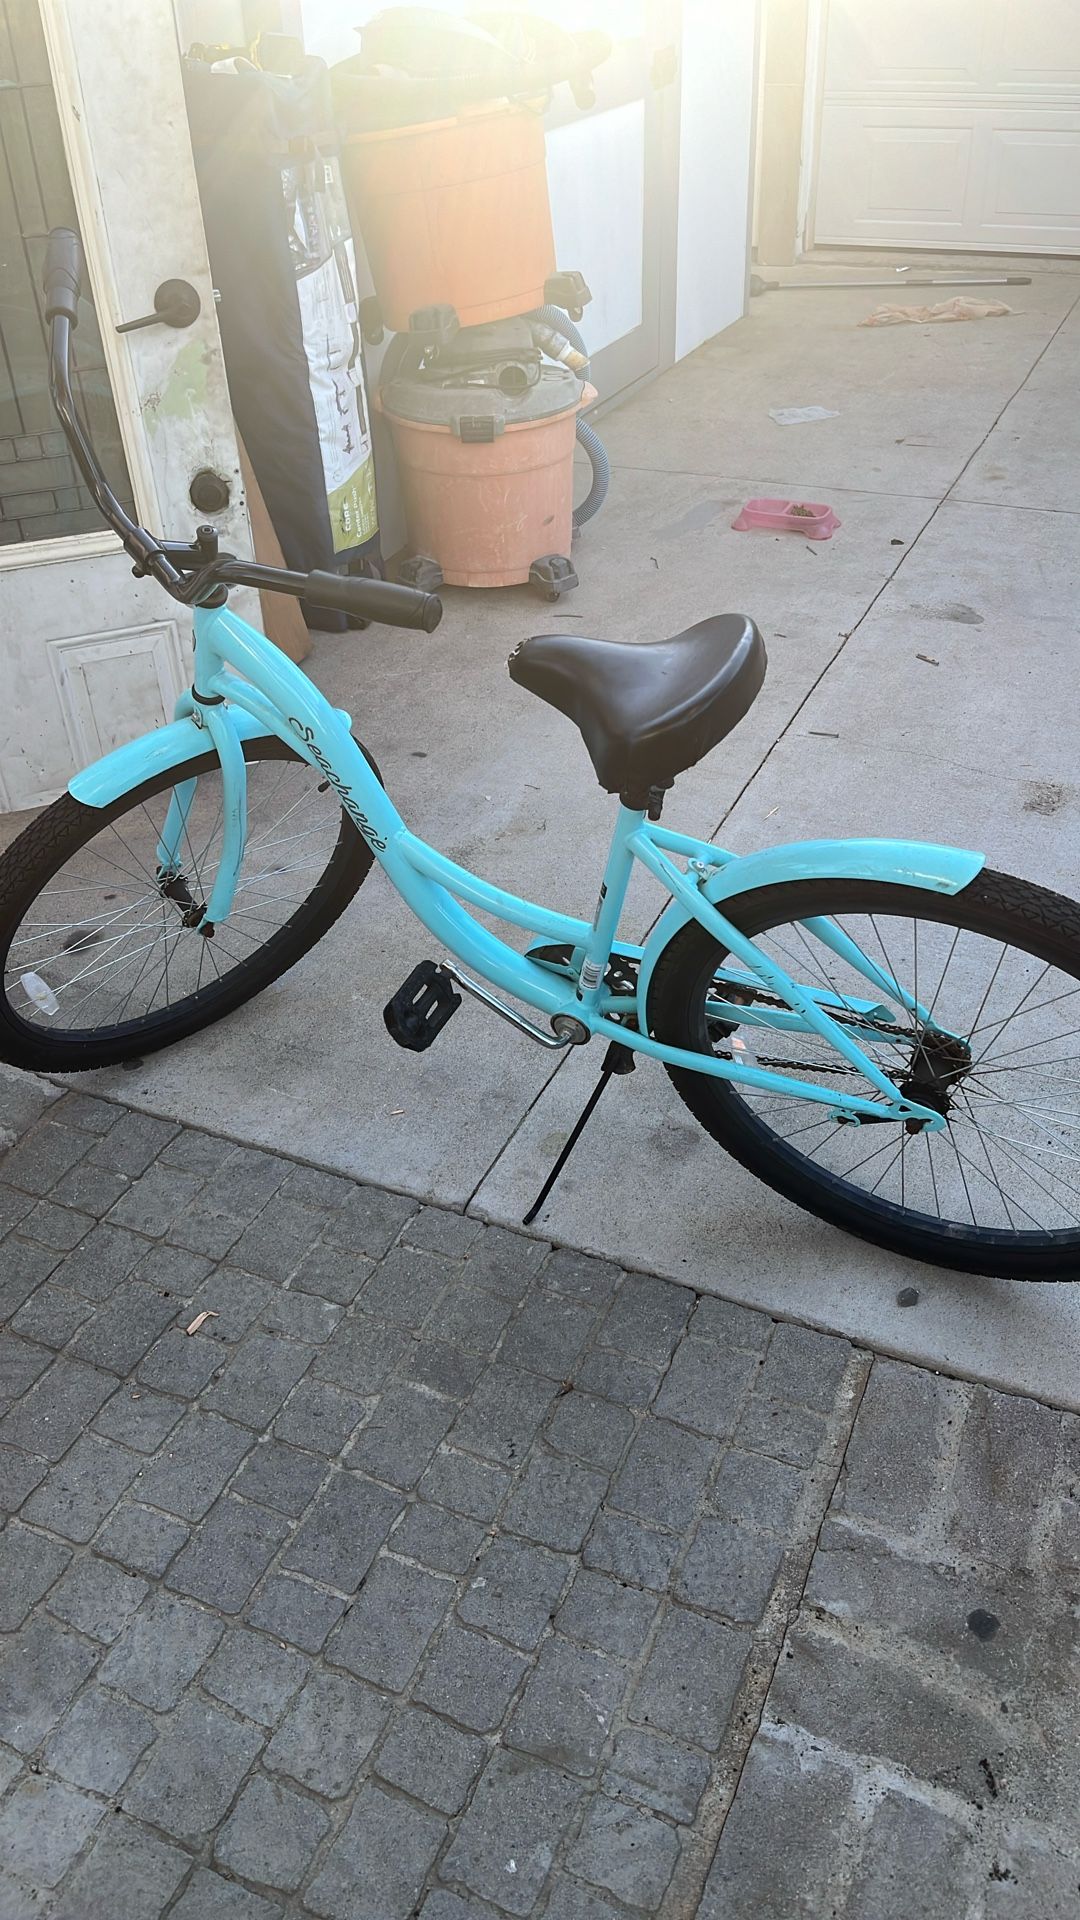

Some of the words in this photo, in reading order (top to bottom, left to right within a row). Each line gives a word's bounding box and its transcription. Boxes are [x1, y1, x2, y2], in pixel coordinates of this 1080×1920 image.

[343, 502, 351, 532] CORE
[354, 510, 362, 538] Center
[289, 717, 387, 853] Seachange
